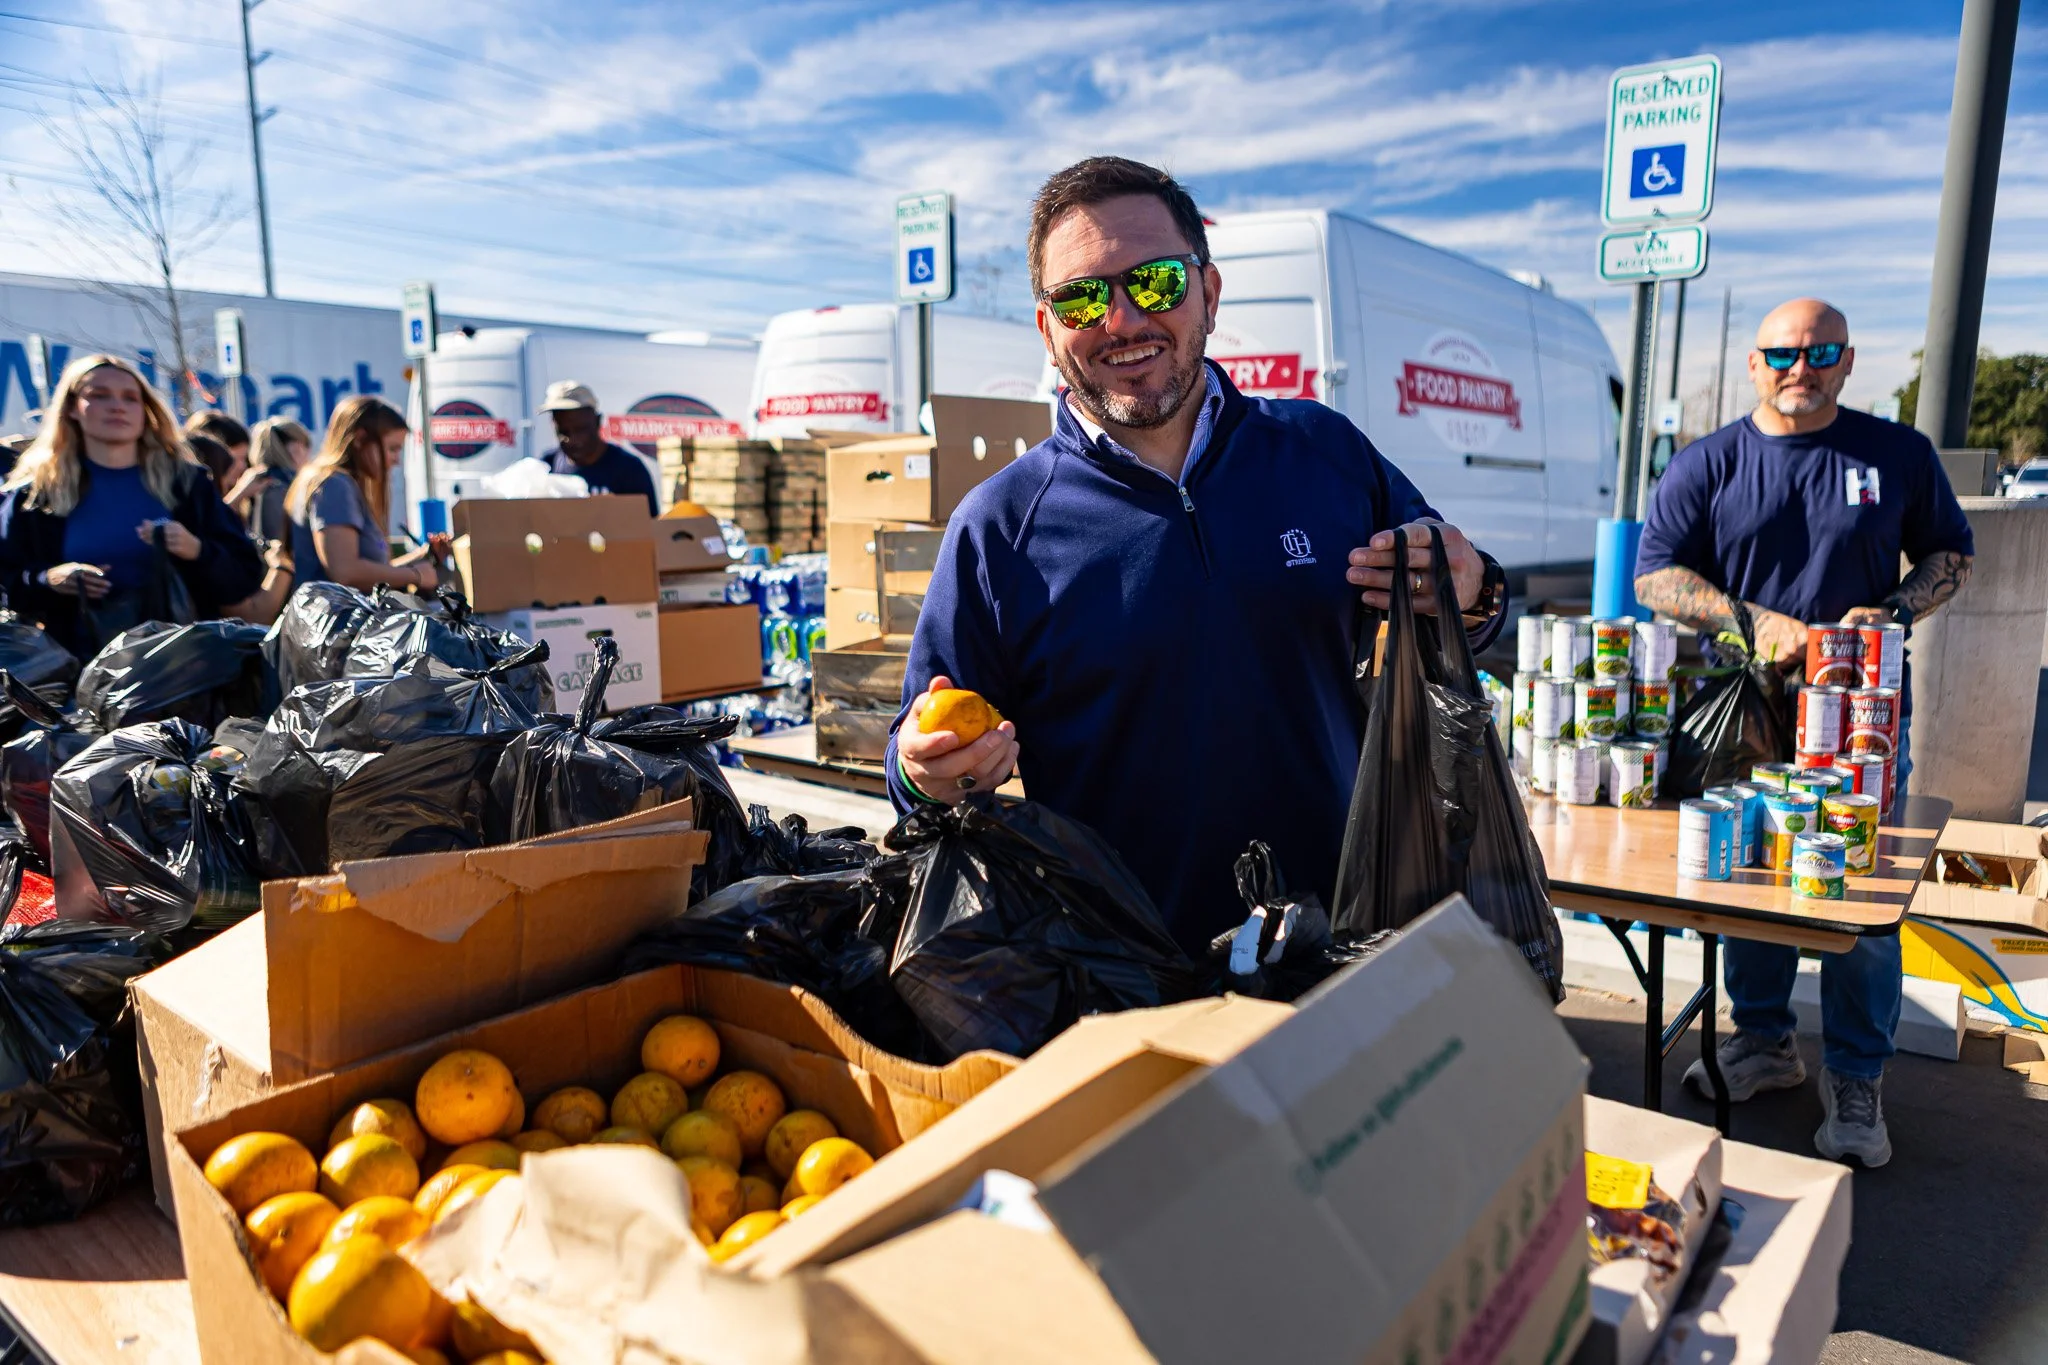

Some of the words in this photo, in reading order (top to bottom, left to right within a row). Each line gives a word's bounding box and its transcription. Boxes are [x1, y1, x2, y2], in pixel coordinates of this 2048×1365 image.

[1618, 73, 1710, 106] RESERVED
[1623, 104, 1702, 132] PARKING
[1633, 239, 1669, 255] VAN
[1414, 369, 1459, 404] FOOD
[1458, 377, 1506, 412] PANTRY
[770, 398, 810, 415] FOOD
[812, 396, 868, 414] PANTRY
